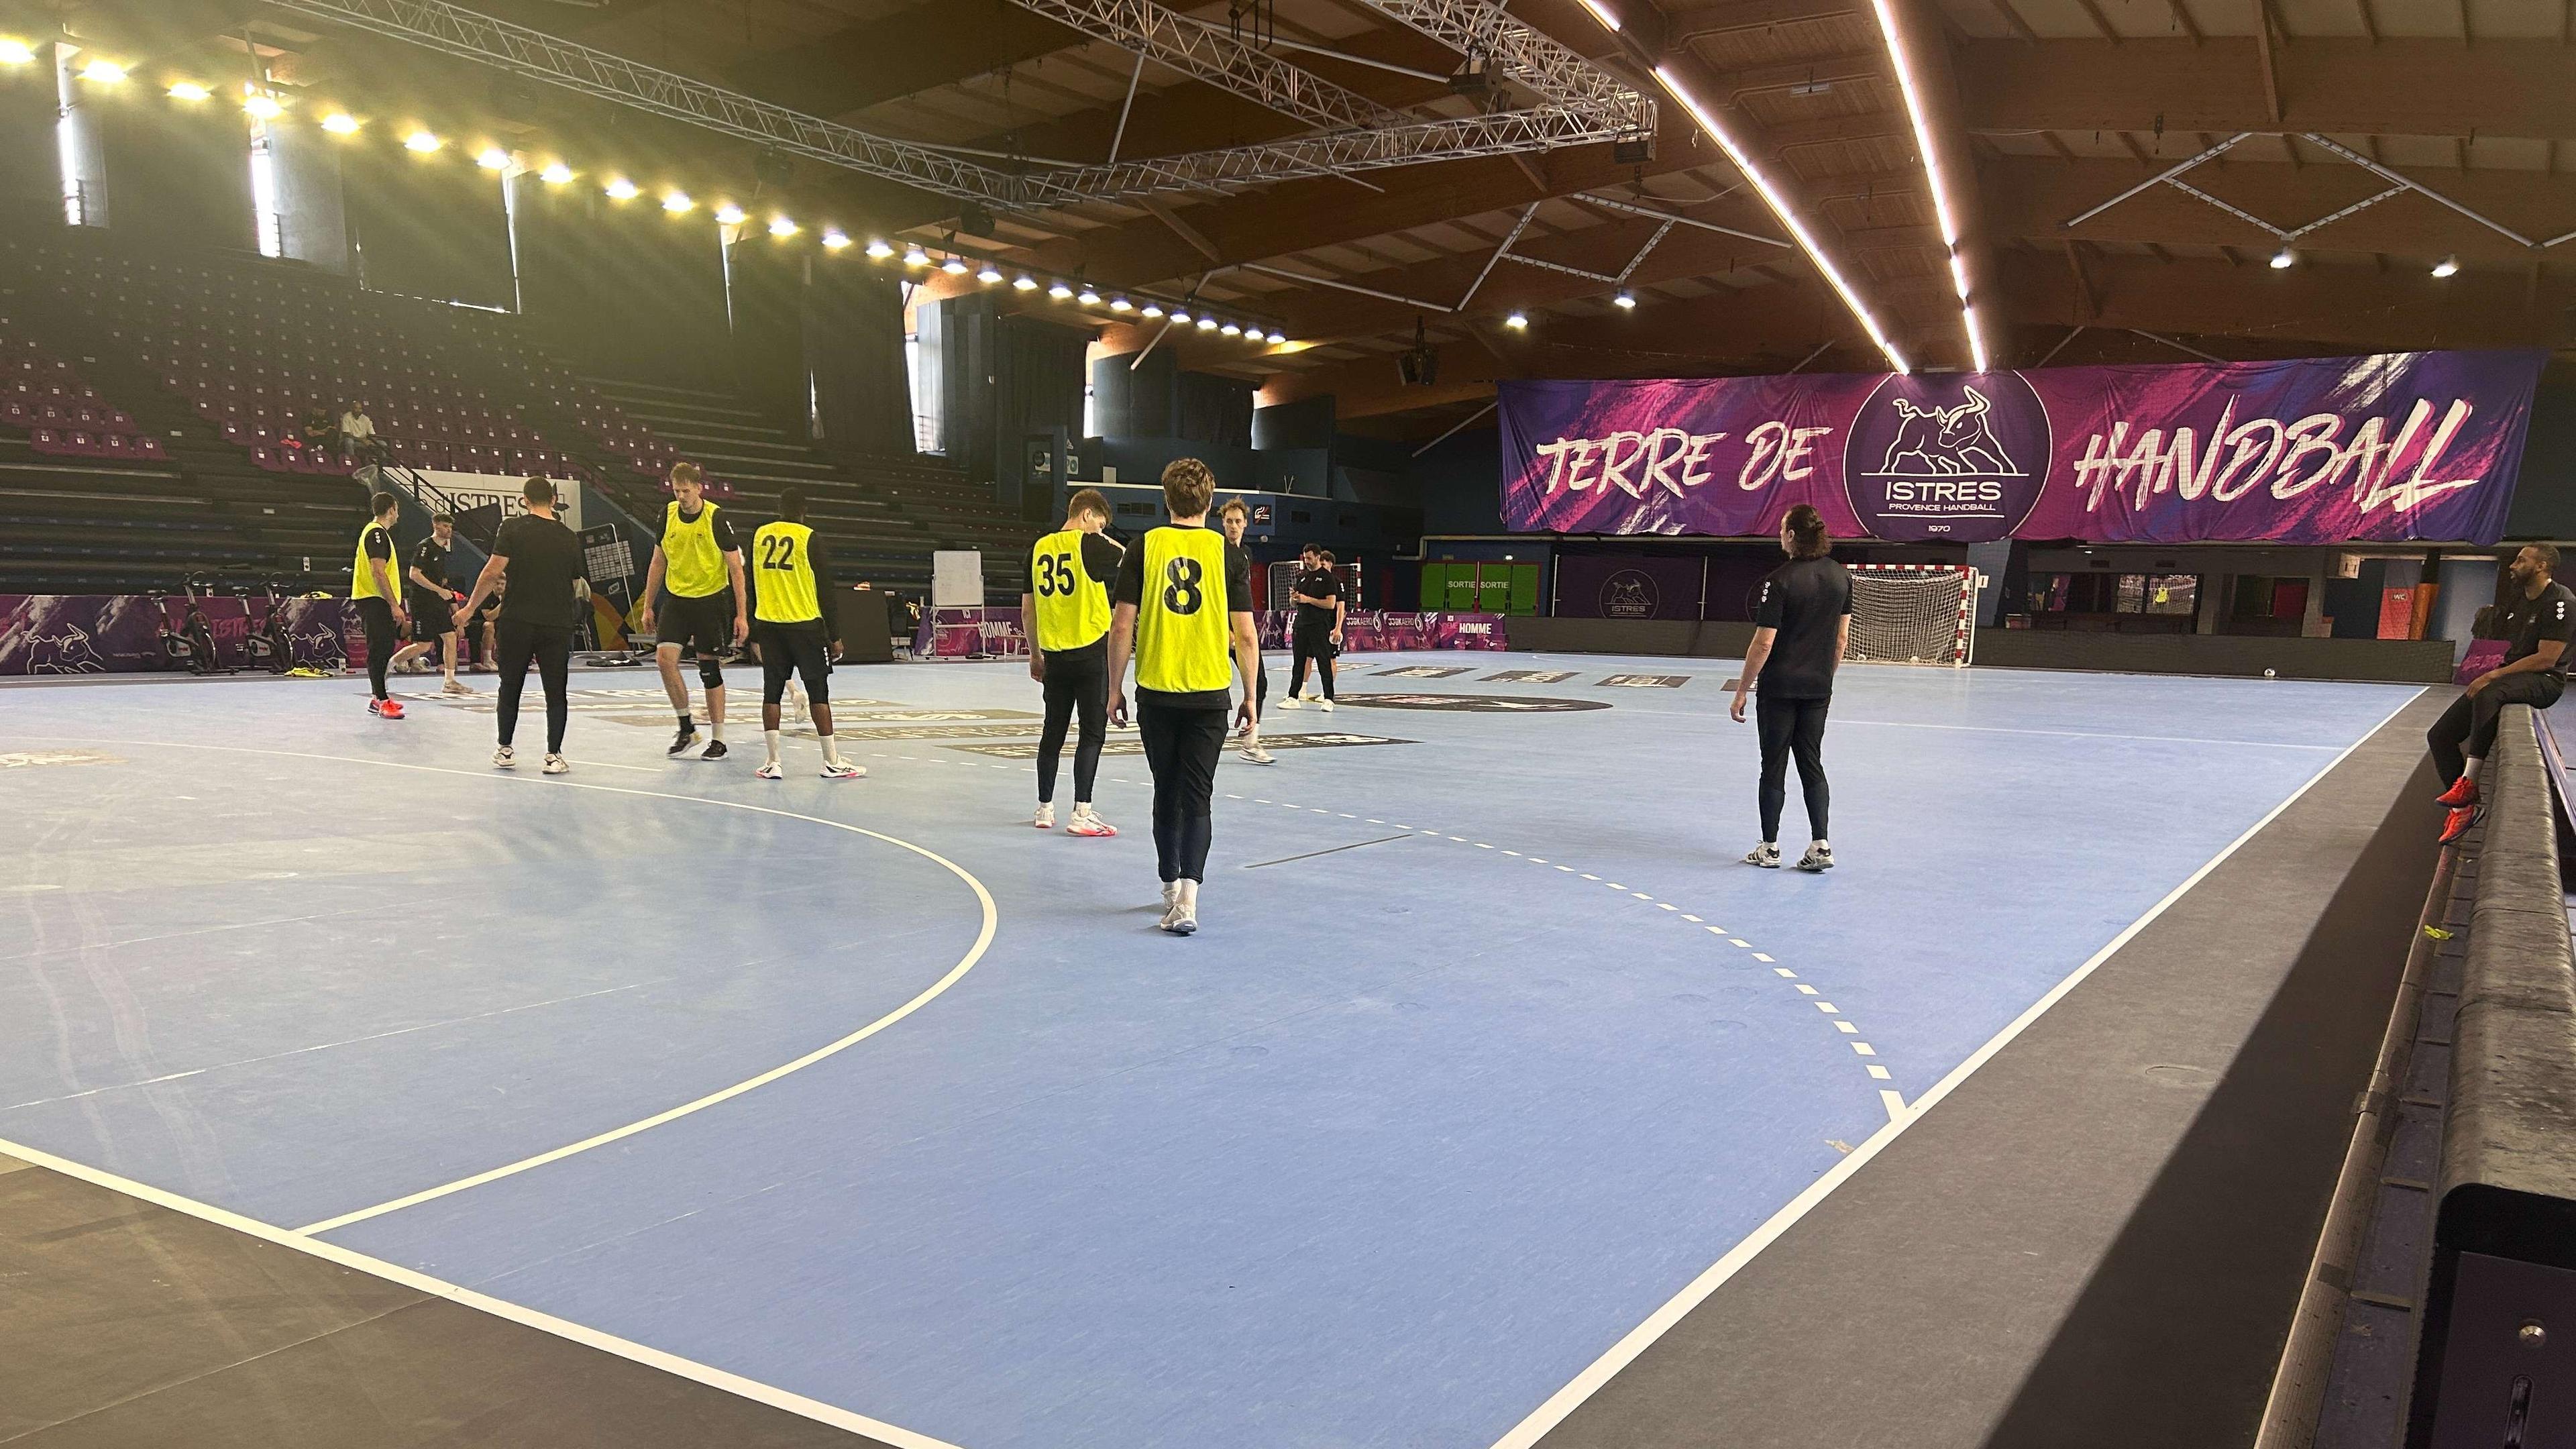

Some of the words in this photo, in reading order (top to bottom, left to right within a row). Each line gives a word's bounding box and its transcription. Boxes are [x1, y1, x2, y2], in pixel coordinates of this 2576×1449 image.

[1537, 427, 1727, 500] TERRE
[1738, 421, 1833, 491] DE
[2074, 394, 2480, 514] HANDBALL
[1885, 482, 2002, 501] ISTRES
[1888, 503, 1941, 512] PROVENCE
[761, 535, 794, 571] 22
[1036, 553, 1075, 597] 35
[1164, 557, 1203, 616] 8
[1459, 623, 1492, 635] HOMME
